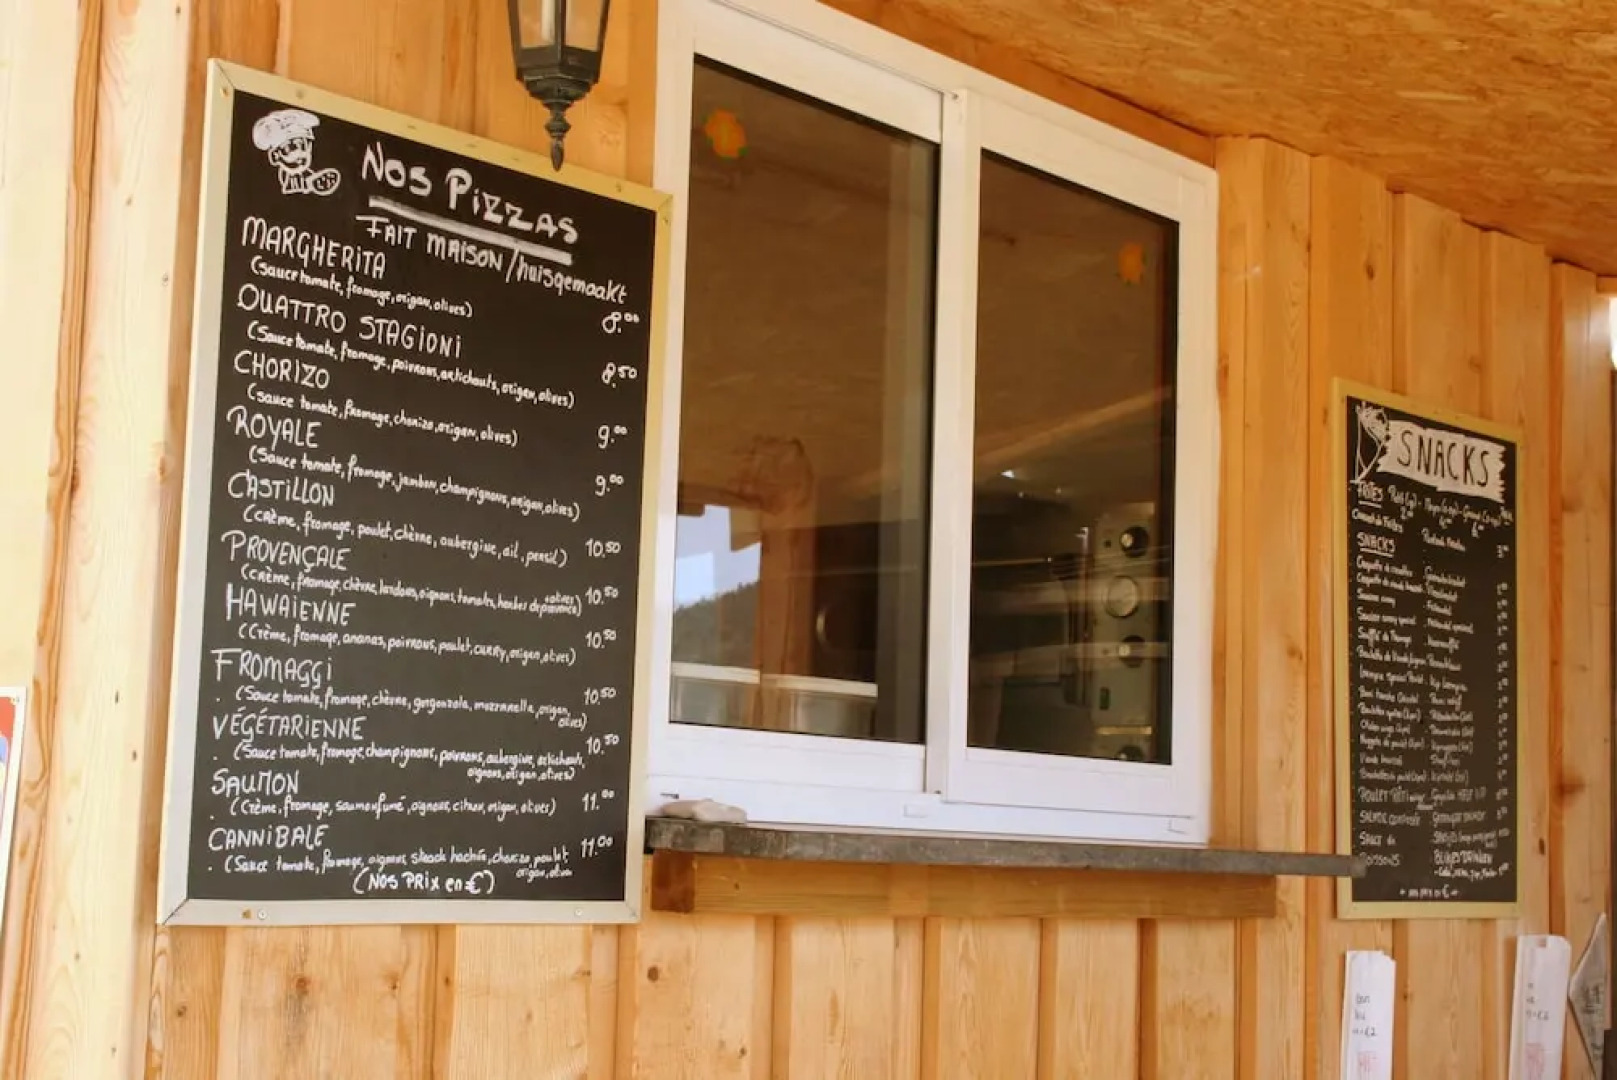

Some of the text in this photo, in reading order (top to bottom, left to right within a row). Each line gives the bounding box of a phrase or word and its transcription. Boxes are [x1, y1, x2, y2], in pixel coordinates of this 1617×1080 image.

[234, 350, 330, 389] CHORIZO
[226, 405, 322, 451] ROYALE
[1396, 429, 1490, 488] SNACKS
[221, 530, 350, 572] PROVENÇALE
